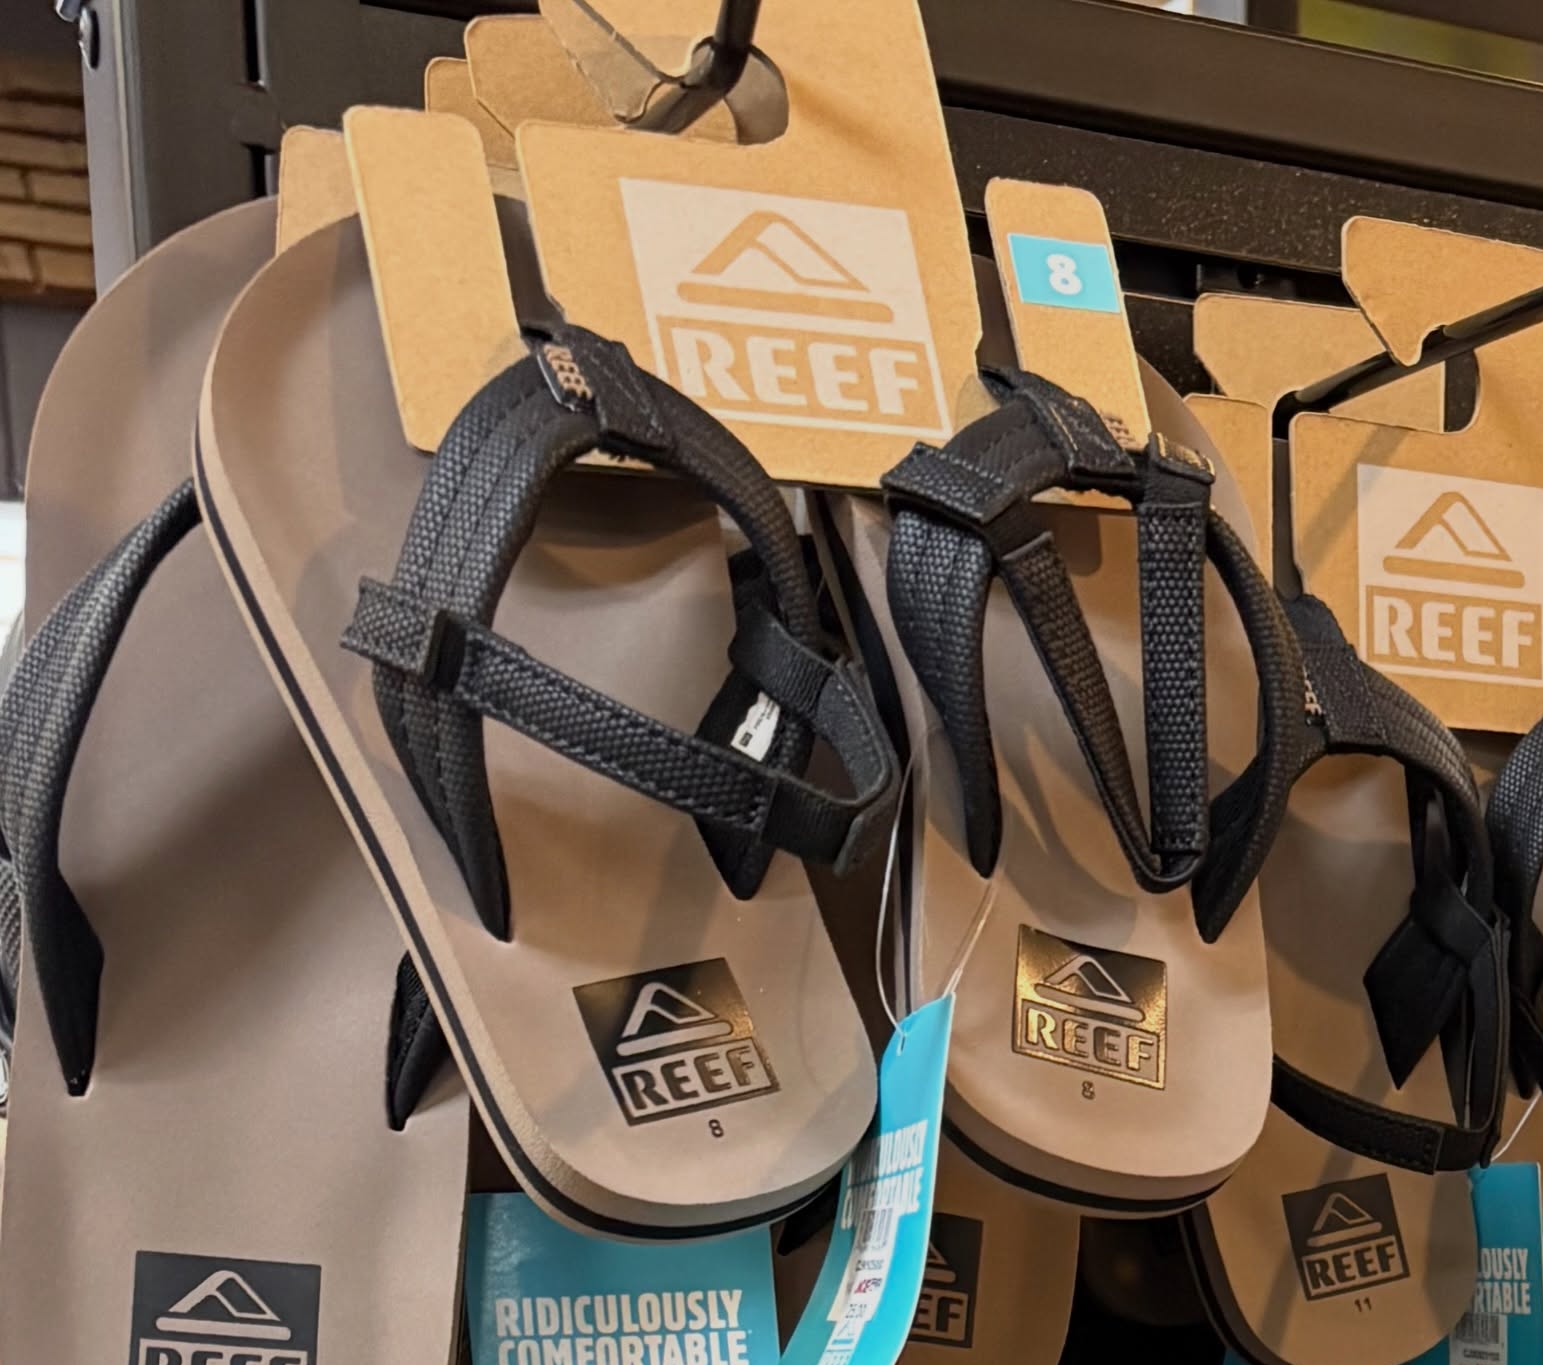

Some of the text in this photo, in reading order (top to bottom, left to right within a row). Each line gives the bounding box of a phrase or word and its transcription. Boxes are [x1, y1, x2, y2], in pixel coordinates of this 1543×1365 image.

[1046, 253, 1083, 296] 8
[667, 326, 922, 417] REEF
[1373, 595, 1535, 669] REEF
[1026, 1007, 1155, 1071] REEF
[620, 1045, 756, 1111] REEF
[1081, 1080, 1096, 1101] 8
[708, 1118, 725, 1139] 8
[1304, 1240, 1398, 1290] REEF
[495, 1289, 743, 1338] RIDICULOUSLY
[911, 1293, 965, 1334] EF
[1353, 1297, 1373, 1313] 11
[1473, 1280, 1532, 1315] RTABLE
